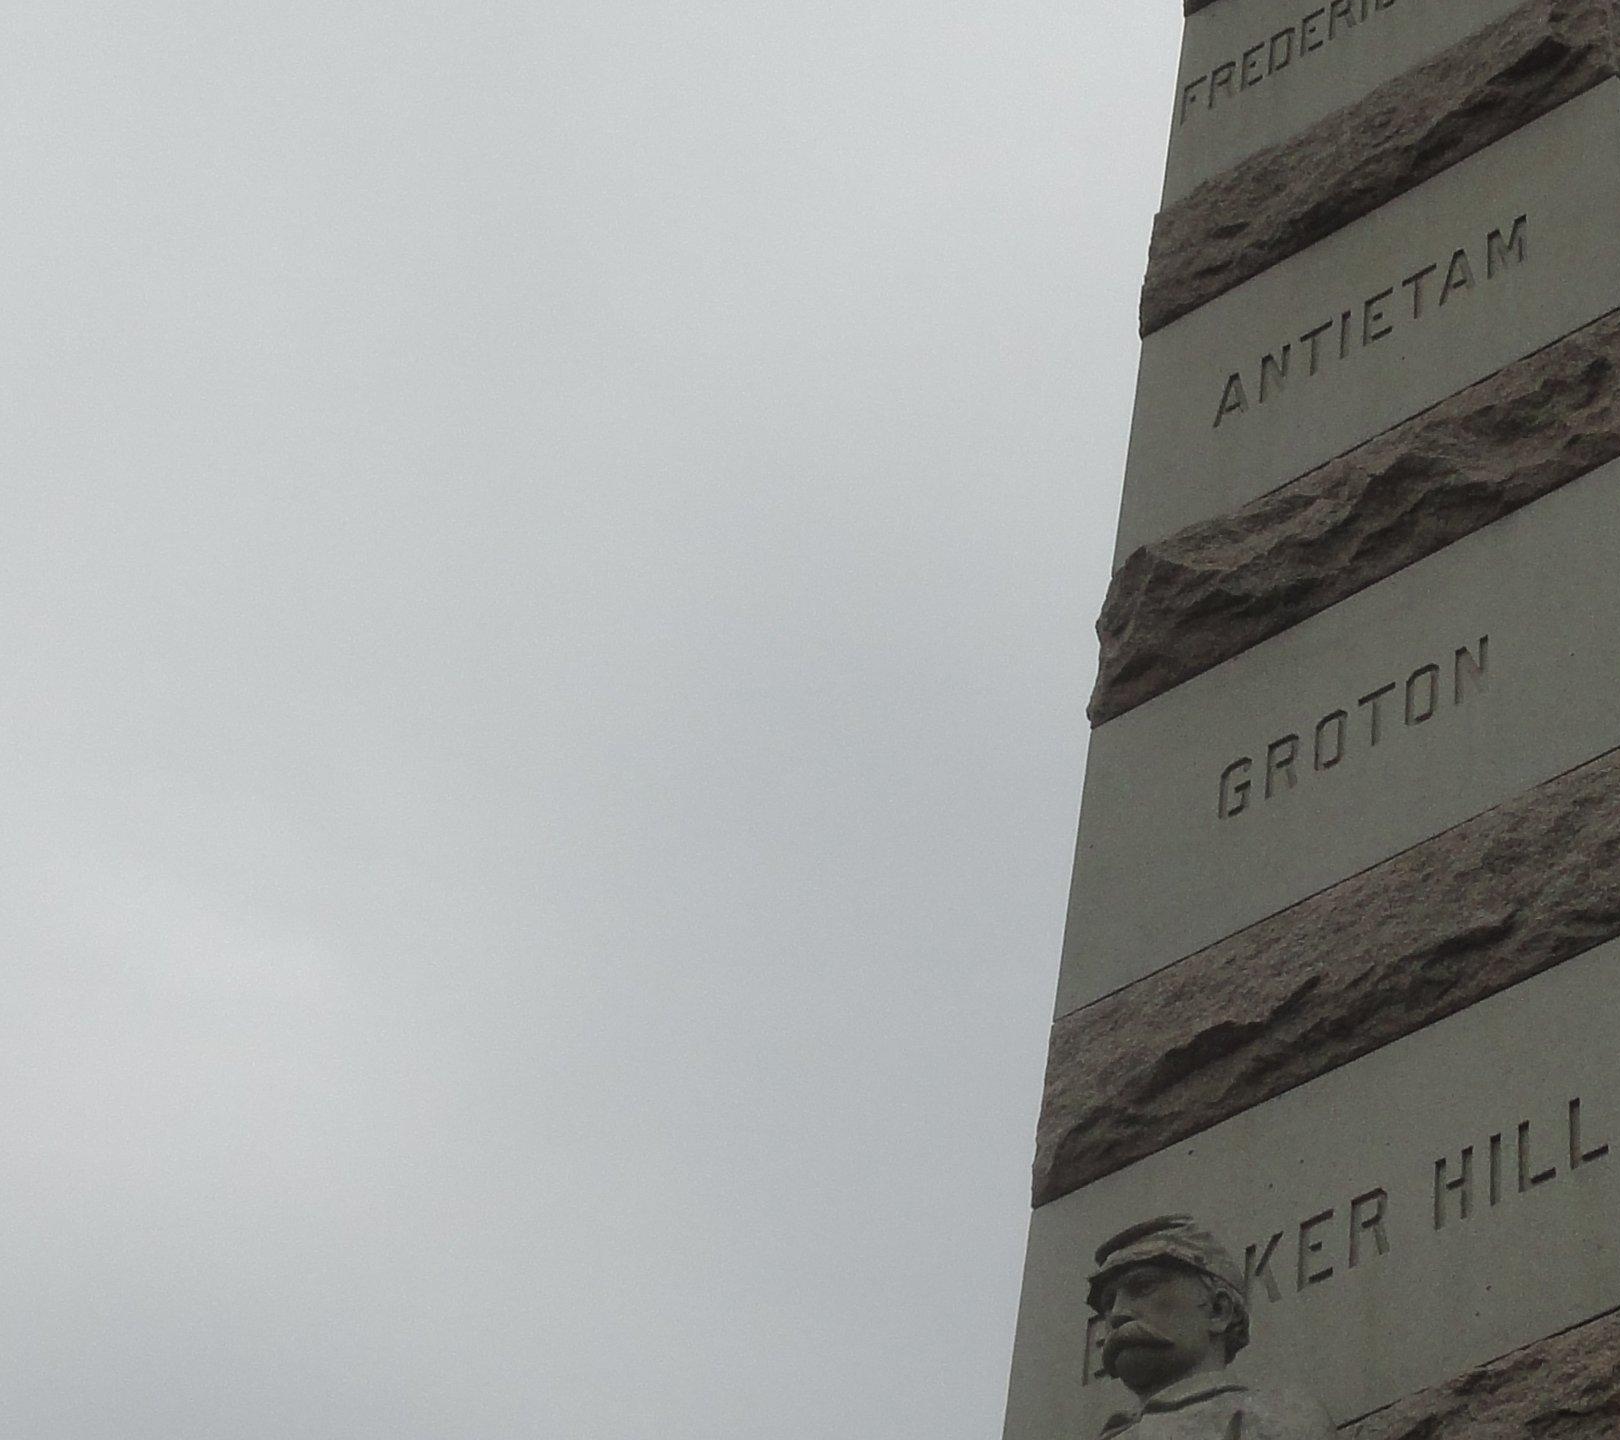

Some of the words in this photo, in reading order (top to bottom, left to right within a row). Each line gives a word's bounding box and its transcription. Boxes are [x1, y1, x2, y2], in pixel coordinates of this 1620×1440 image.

[1212, 214, 1528, 428] ANTIETAM
[1217, 634, 1489, 819] GROTON
[1433, 1097, 1610, 1231] HILL
